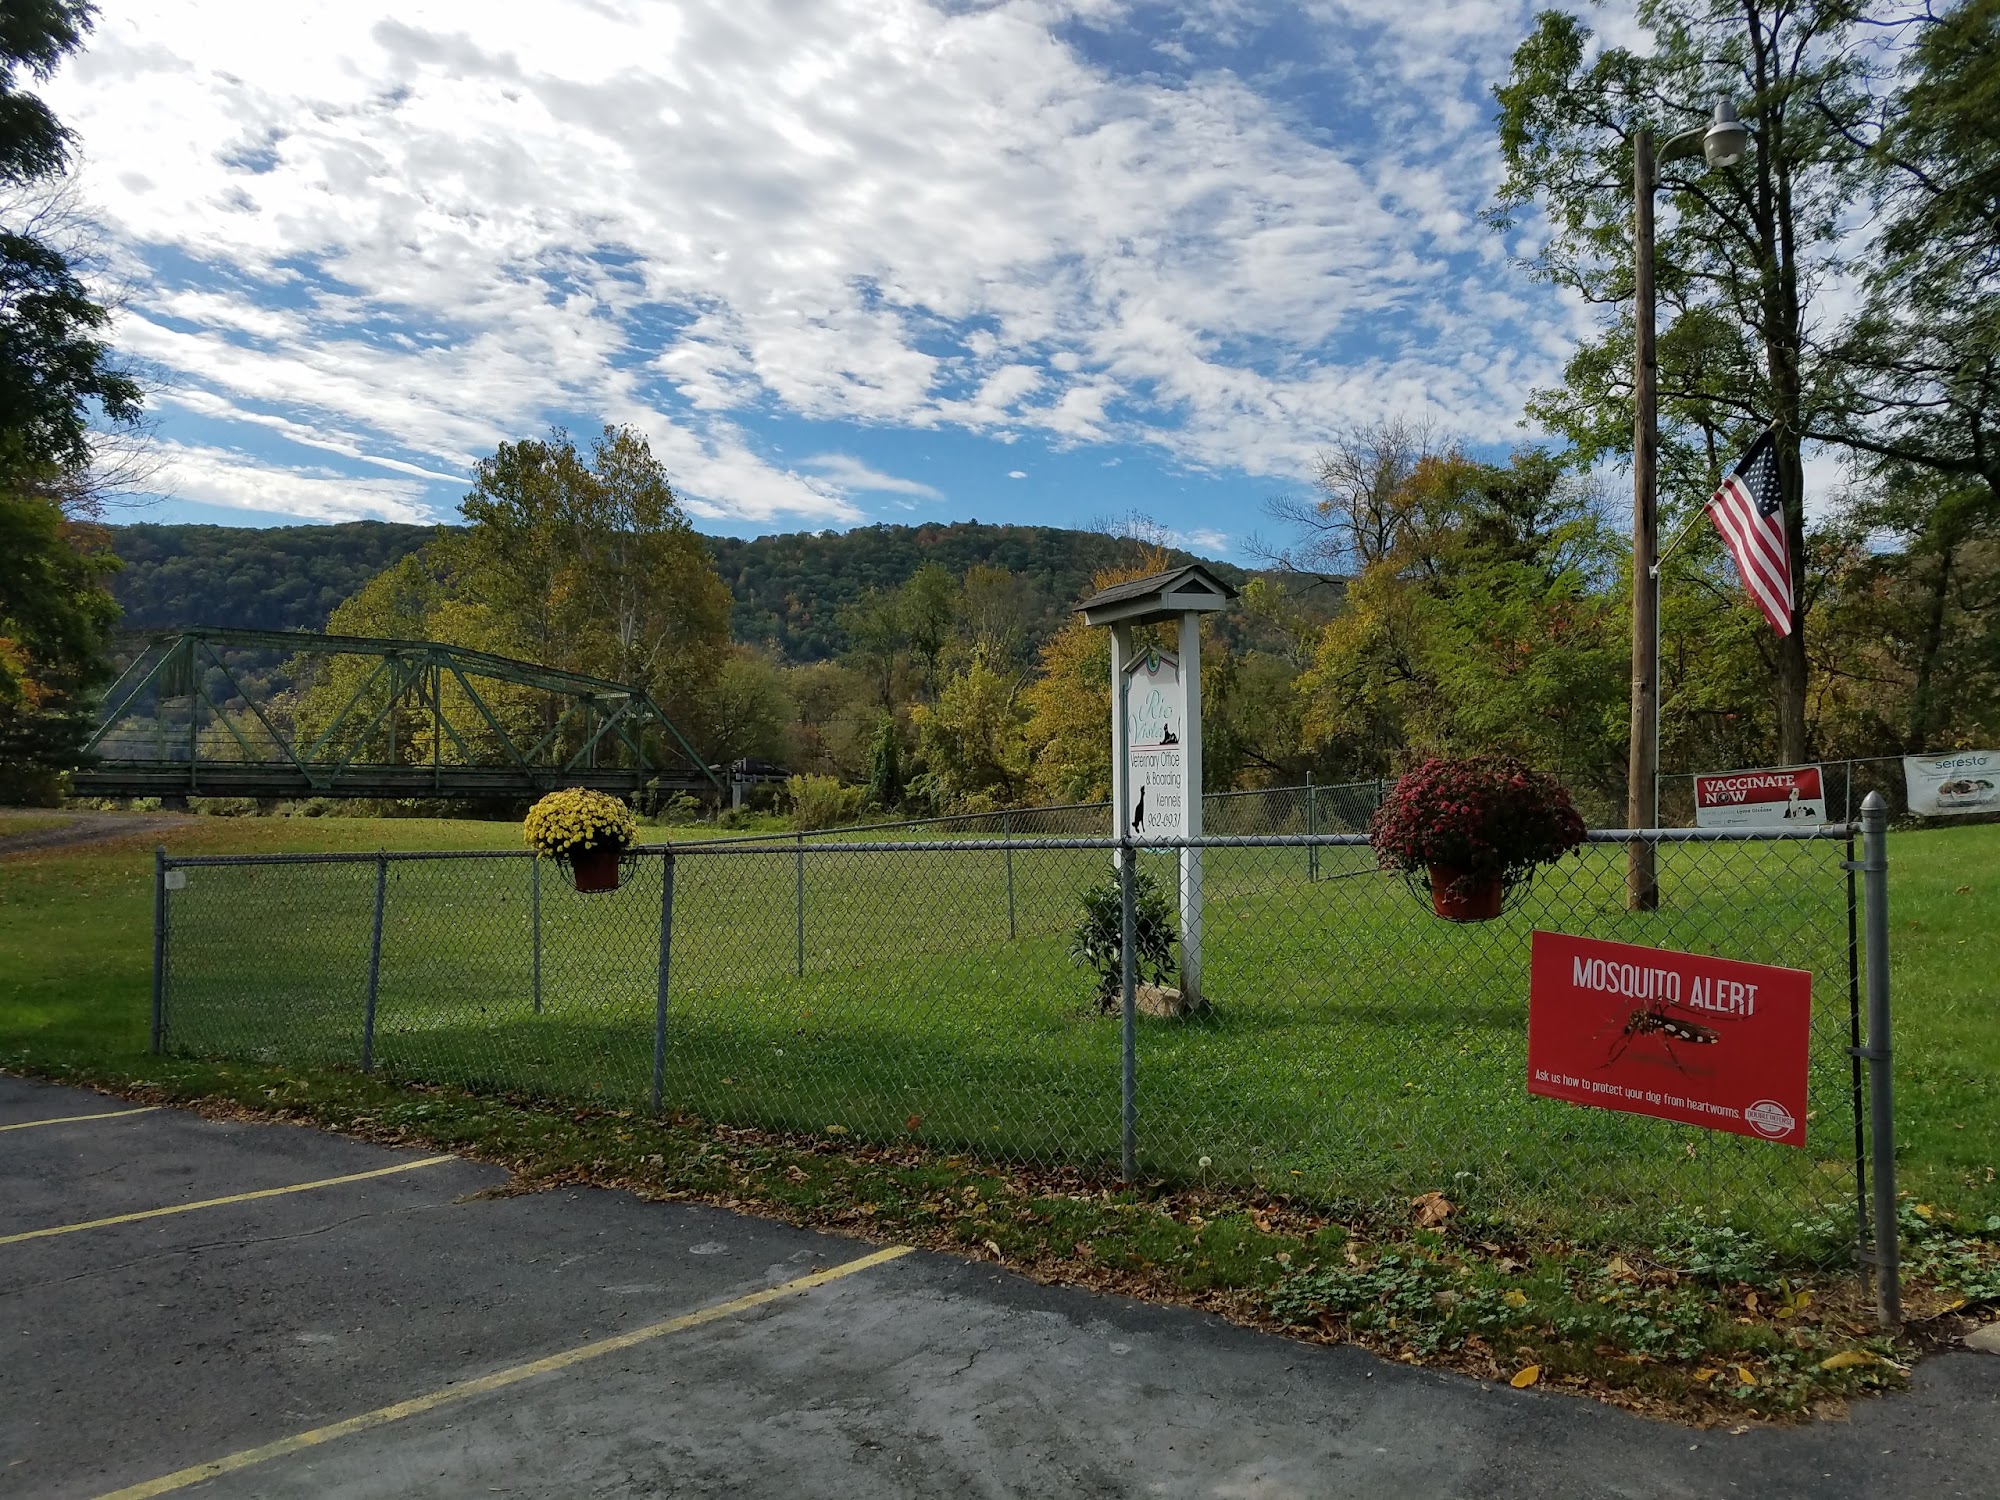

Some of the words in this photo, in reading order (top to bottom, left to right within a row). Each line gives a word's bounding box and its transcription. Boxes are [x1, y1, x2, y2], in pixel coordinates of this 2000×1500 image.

[1138, 688, 1173, 722] Rio
[1128, 714, 1163, 744] Vista
[1130, 752, 1160, 769] Veterinary
[1160, 751, 1180, 767] Office
[1145, 771, 1151, 785] &
[1152, 771, 1181, 789] Boarding
[1704, 774, 1796, 792] VACCINATE
[1156, 792, 1181, 807] Kennels
[1704, 789, 1748, 804] NOW
[1573, 955, 1681, 1004] MOSQUITO
[1689, 975, 1759, 1016] ALERT
[1535, 1068, 1549, 1082] Ask
[1551, 1073, 1561, 1084] us
[1562, 1073, 1580, 1088] how
[1581, 1078, 1591, 1090] to
[1592, 1082, 1623, 1096] protect
[1625, 1087, 1644, 1100] your
[1645, 1089, 1661, 1105] dog
[1664, 1093, 1685, 1108] from
[1686, 1097, 1741, 1120] heartworms.
[1747, 1109, 1769, 1120] DOUBLE
[1769, 1113, 1793, 1127] DEFENSE
